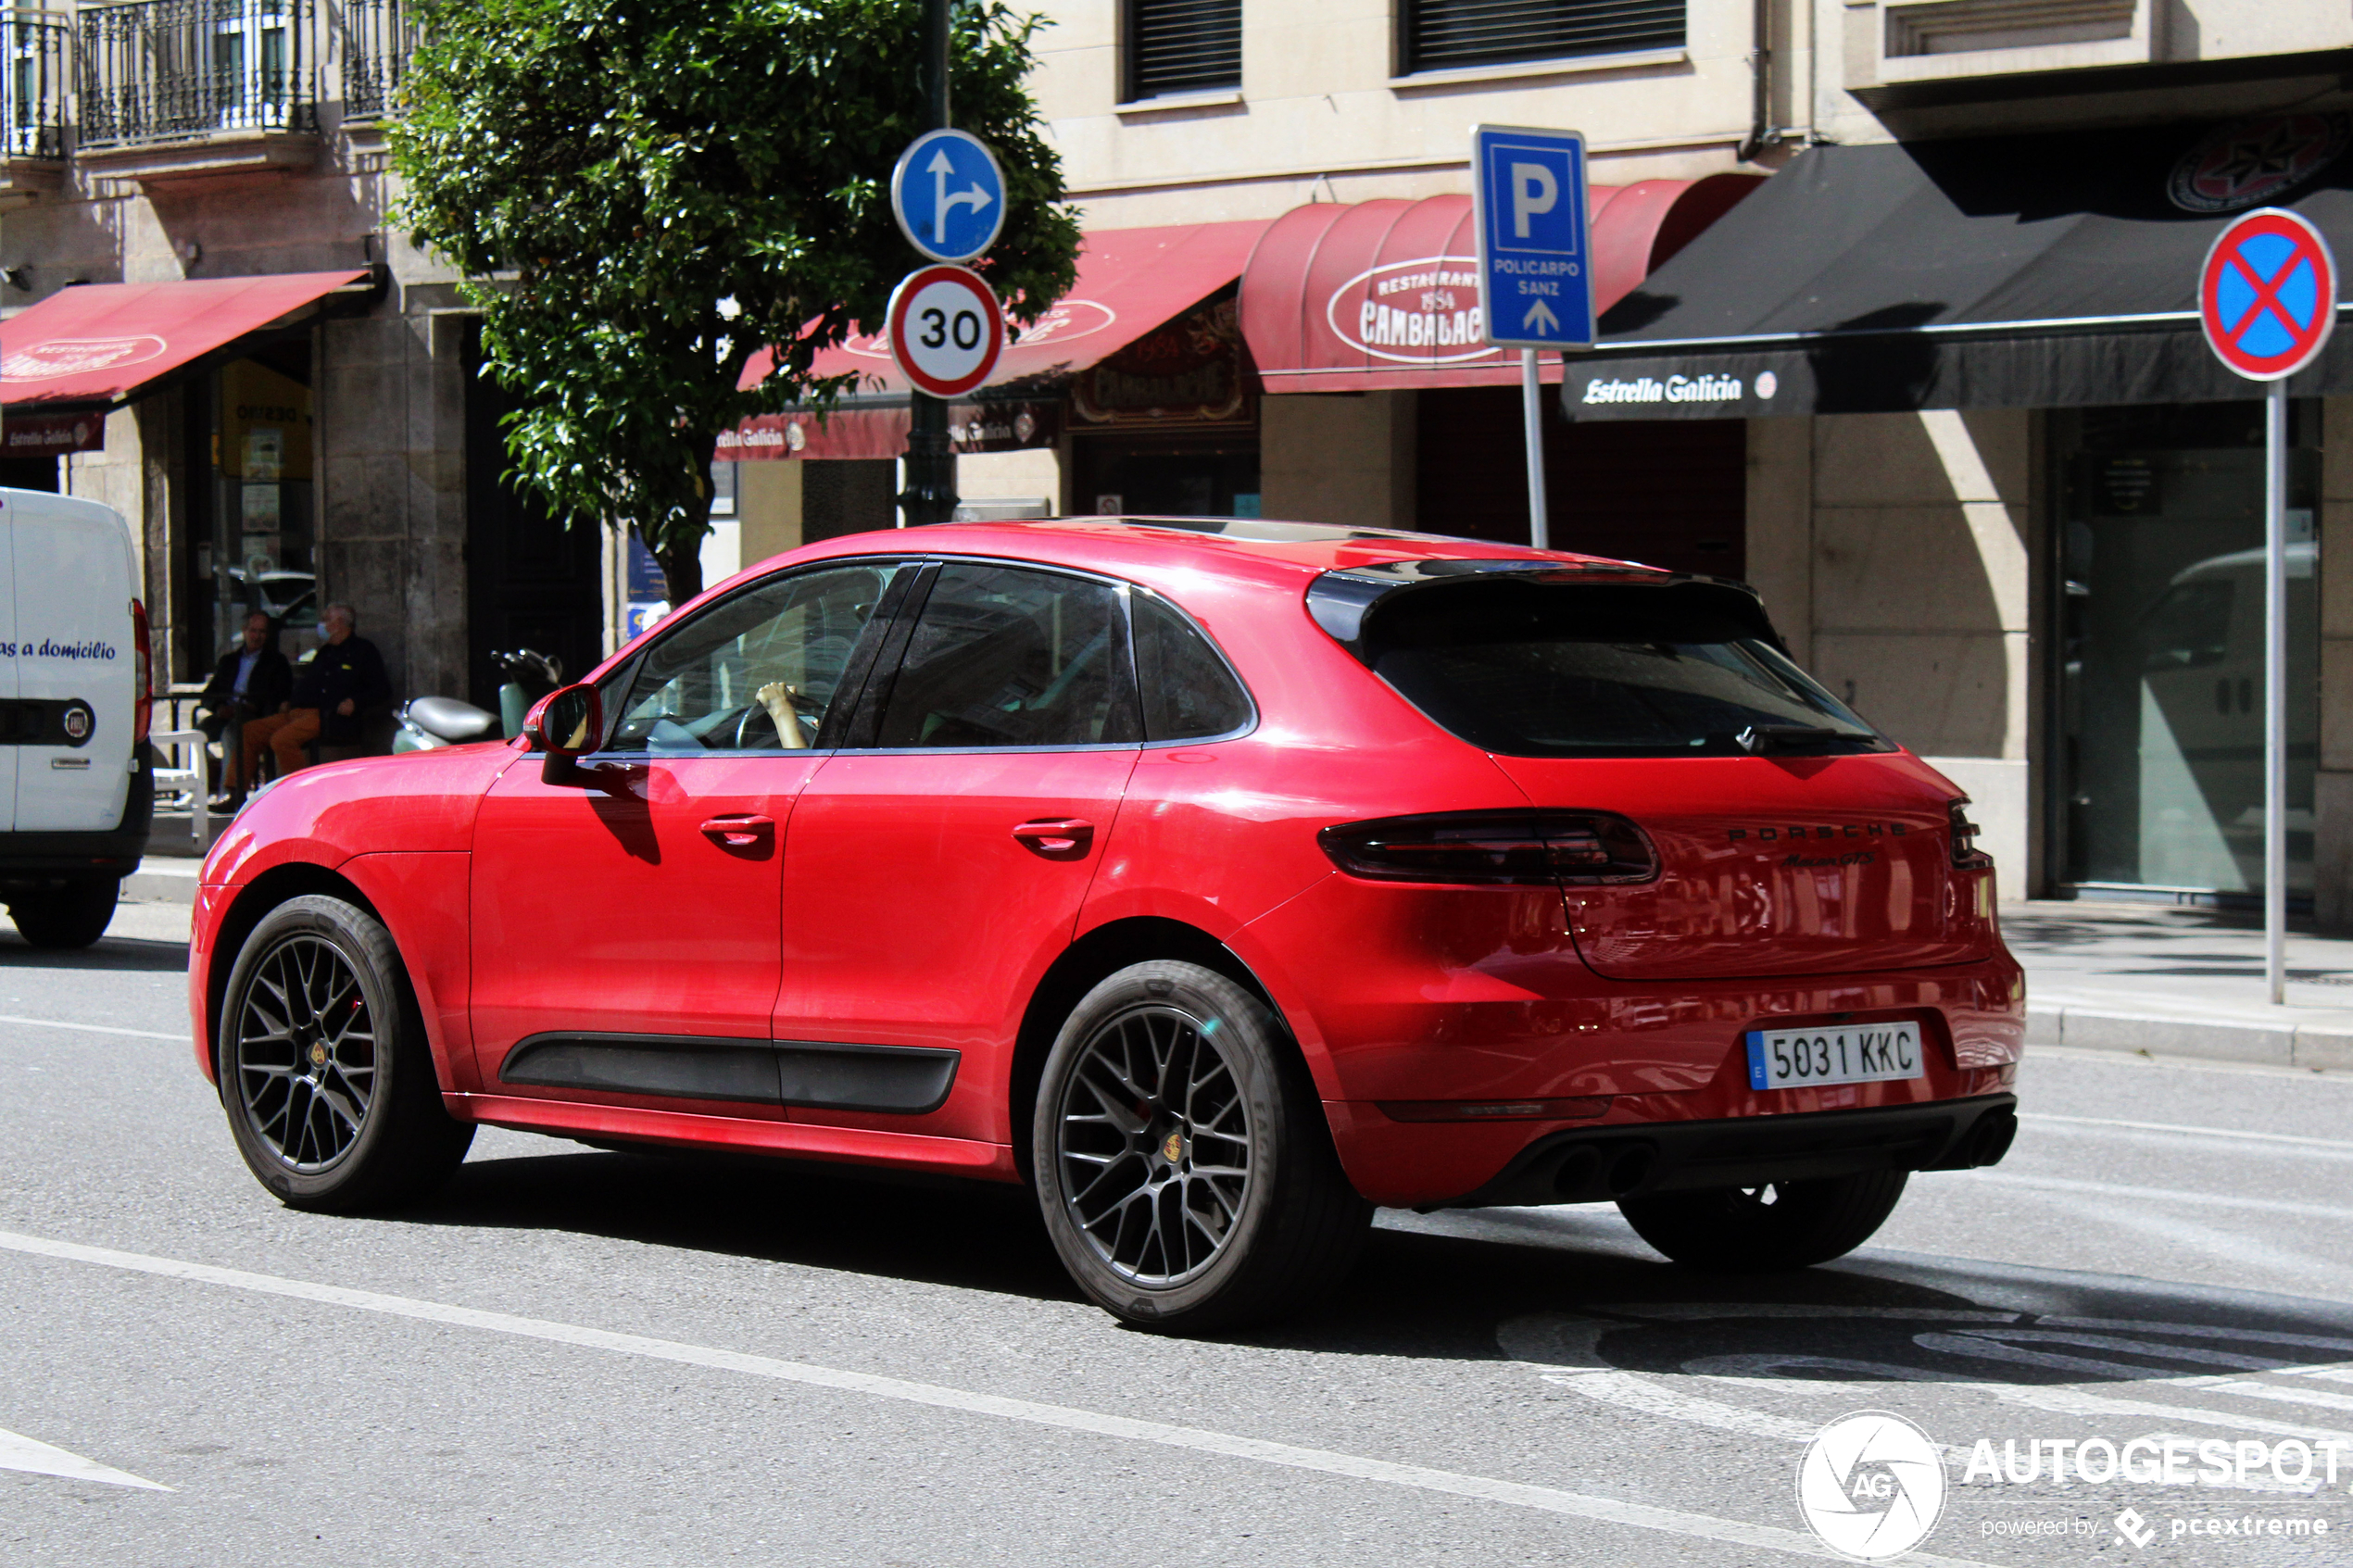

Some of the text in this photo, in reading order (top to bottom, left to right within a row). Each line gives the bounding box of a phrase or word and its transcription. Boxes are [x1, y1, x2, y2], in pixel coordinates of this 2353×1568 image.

[1511, 161, 1558, 238] P
[1493, 258, 1580, 277] POLICARPO
[1377, 270, 1480, 296] RESTAURANT
[1517, 280, 1560, 296] SANZ
[920, 307, 981, 351] 30
[1359, 298, 1482, 346] CAMBALAC
[1581, 372, 1743, 405] Estrella Galicia
[743, 427, 785, 447] Galicia
[21, 642, 34, 657] a
[38, 637, 116, 660] domicilio
[1728, 822, 1907, 843] PORSCHE
[1780, 851, 1876, 868] Macan GTS
[1772, 1031, 1913, 1080] 5031 KKC
[1754, 1066, 1763, 1079] E
